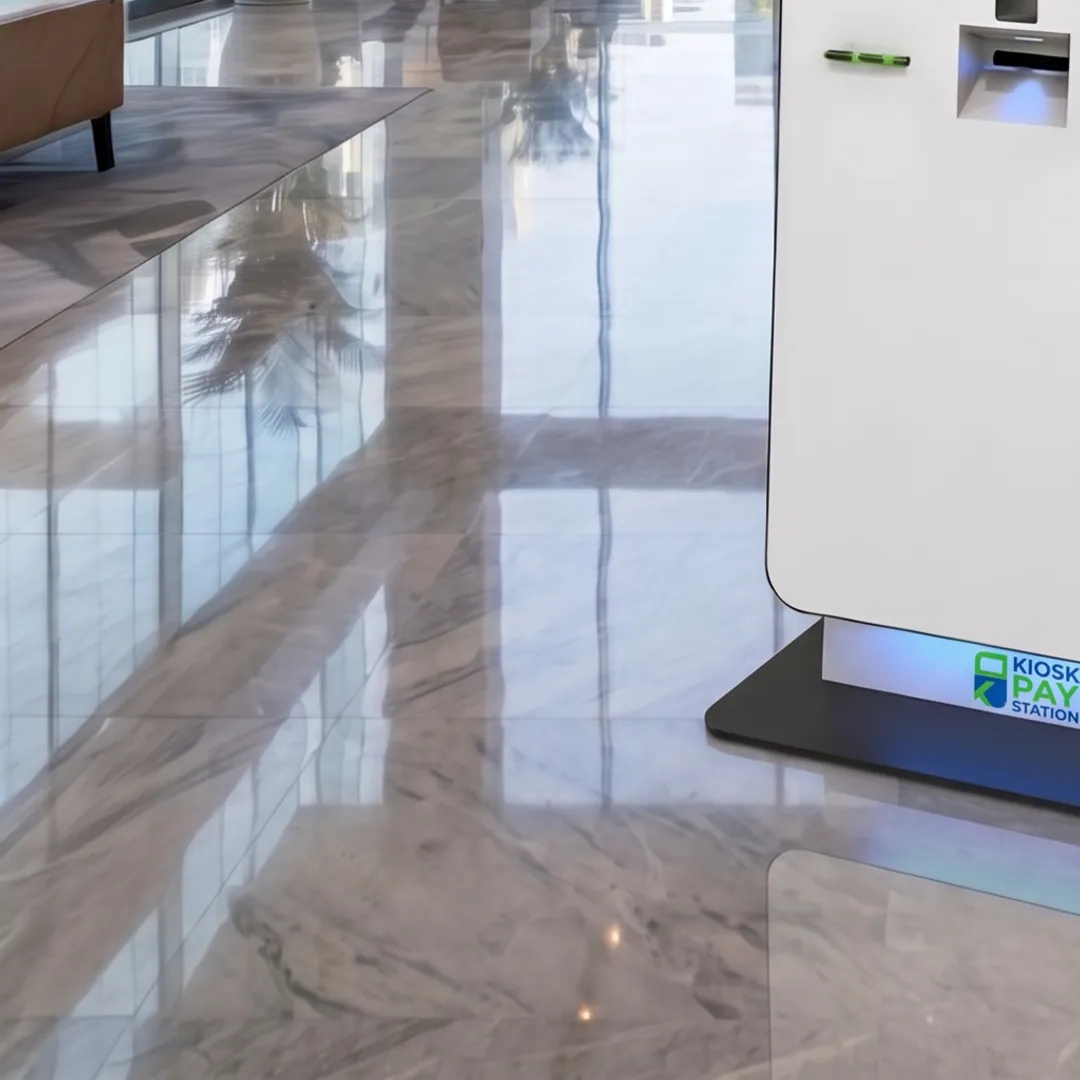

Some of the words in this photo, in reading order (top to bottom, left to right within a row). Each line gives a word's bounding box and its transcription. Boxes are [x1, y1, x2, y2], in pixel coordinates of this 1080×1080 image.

[1013, 656, 1080, 684] KIOSK
[1013, 674, 1079, 708] PAY
[1012, 700, 1079, 724] STATION
